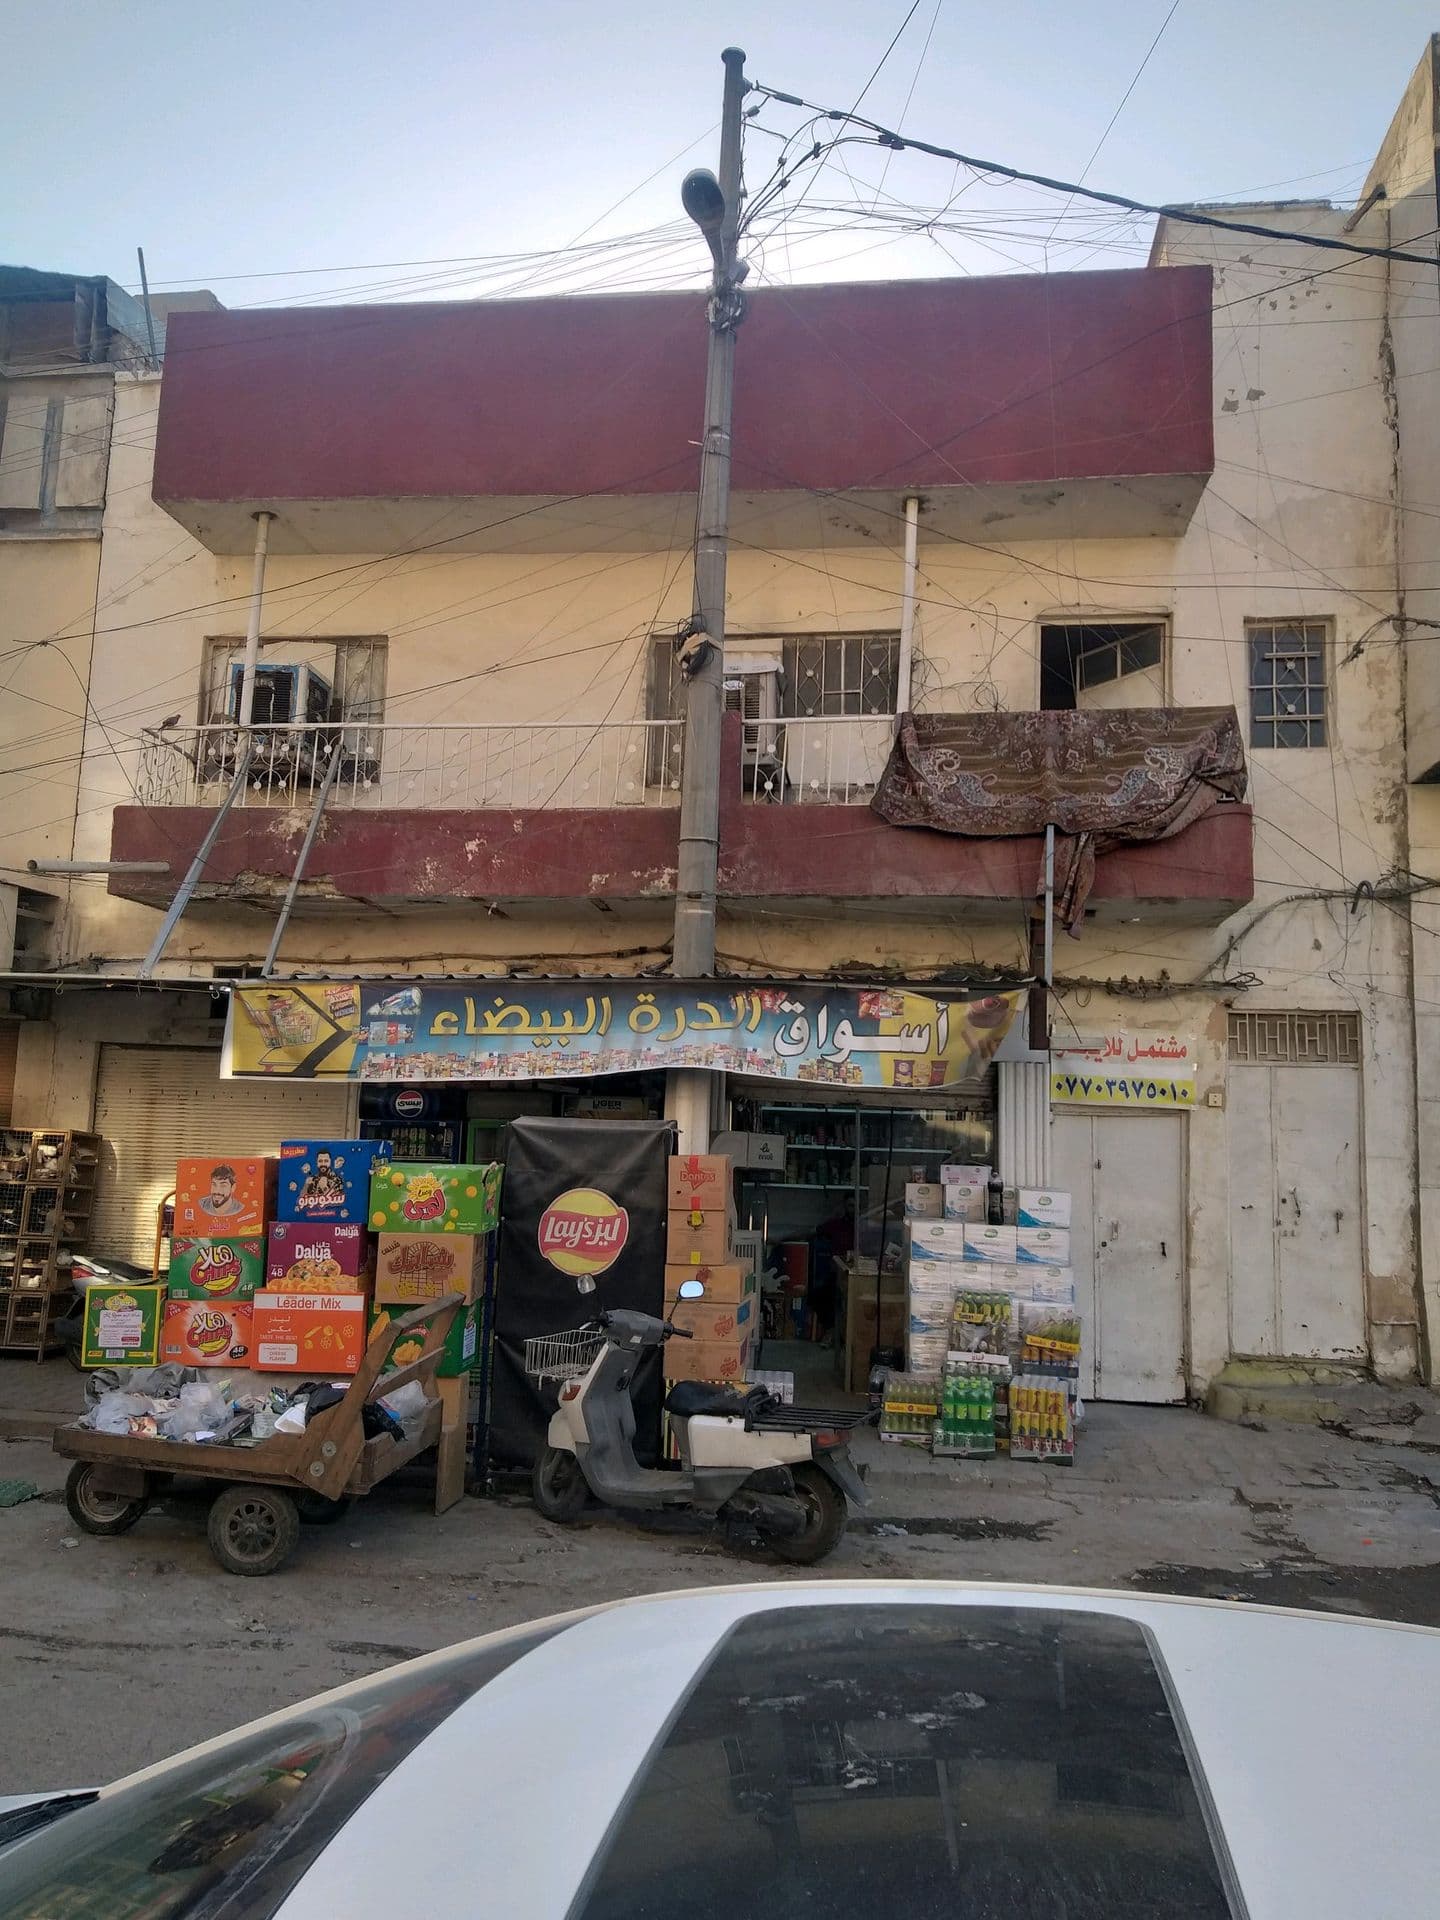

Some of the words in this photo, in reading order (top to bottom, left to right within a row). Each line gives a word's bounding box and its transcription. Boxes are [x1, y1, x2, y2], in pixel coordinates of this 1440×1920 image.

[429, 996, 612, 1048] البيضاء
[628, 992, 762, 1042] الدرة
[773, 1000, 949, 1063] أسواق
[1127, 1035, 1188, 1063] مشتمل
[1055, 1075, 1189, 1101] ٠٧٧٠٣٩٧٥٠١٠
[334, 1226, 359, 1238] Dalya
[543, 1216, 594, 1248] Lay's
[585, 1217, 622, 1246] ليز
[295, 1244, 332, 1262] Dalya
[271, 1267, 283, 1277] 48
[276, 1296, 317, 1309] Leader
[320, 1297, 342, 1309] Mix
